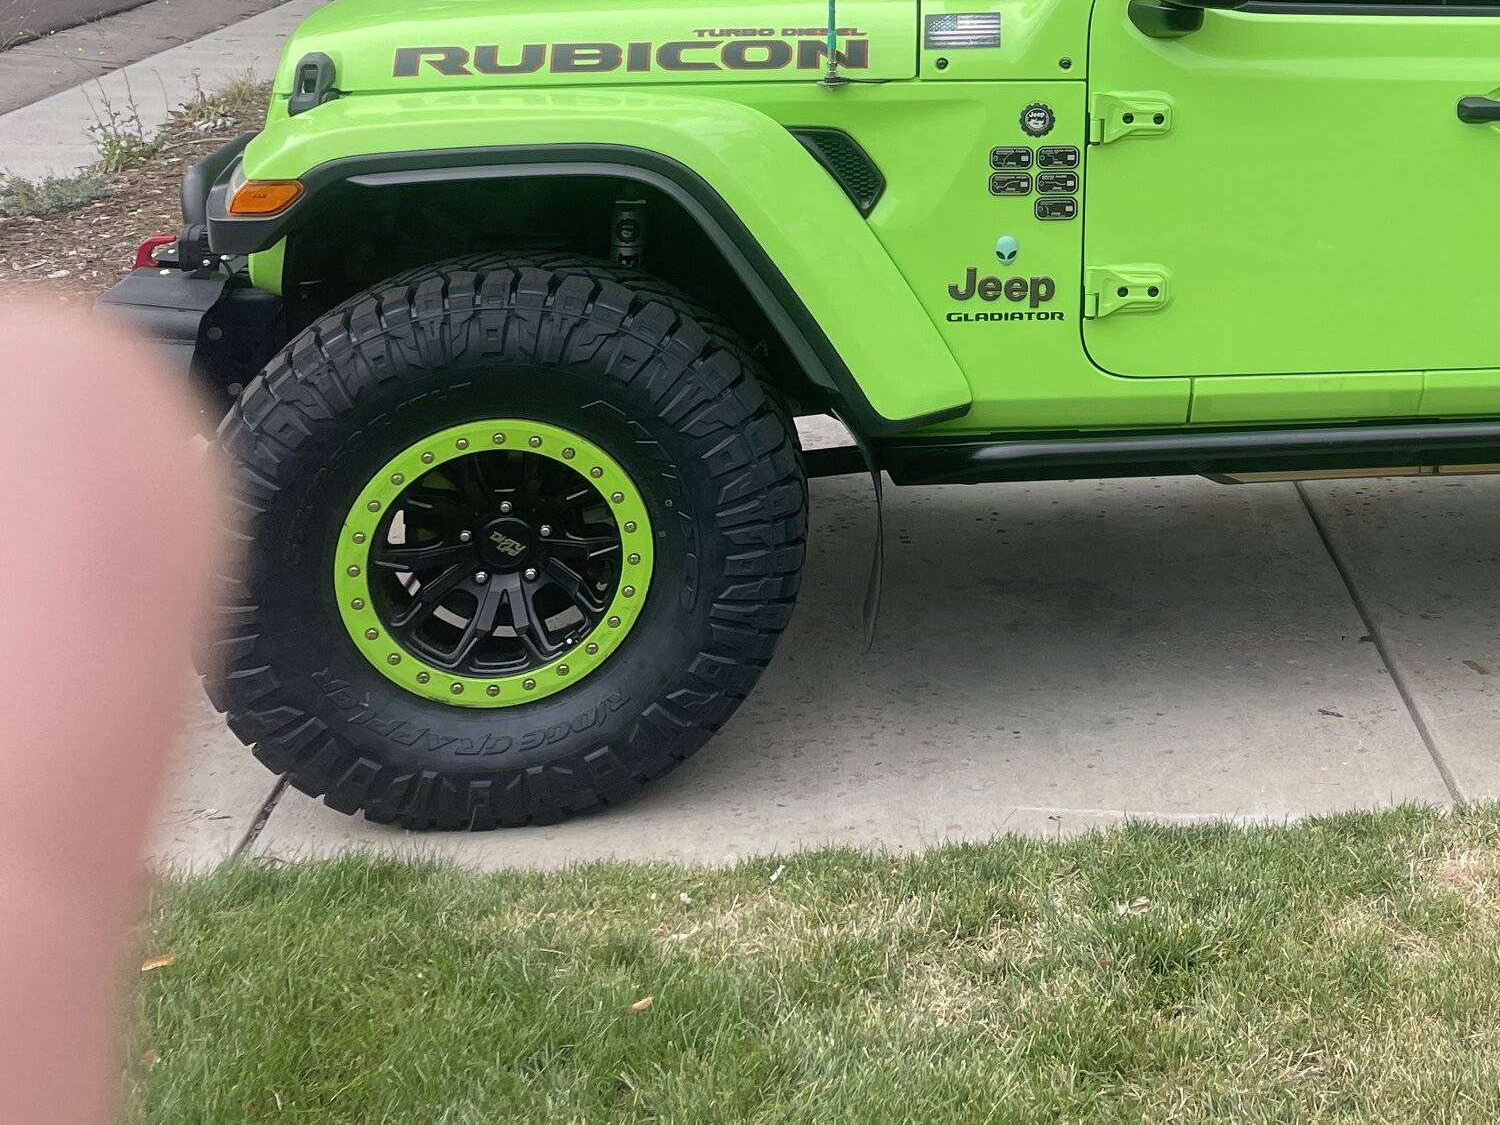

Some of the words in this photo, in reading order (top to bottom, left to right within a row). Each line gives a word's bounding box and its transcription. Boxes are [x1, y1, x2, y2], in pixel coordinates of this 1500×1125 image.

[692, 28, 775, 38] TURBO
[781, 27, 868, 37] DIESEL
[392, 39, 870, 78] RUBICON
[948, 266, 1055, 308] Jeep
[946, 311, 1065, 323] GLADIATOR
